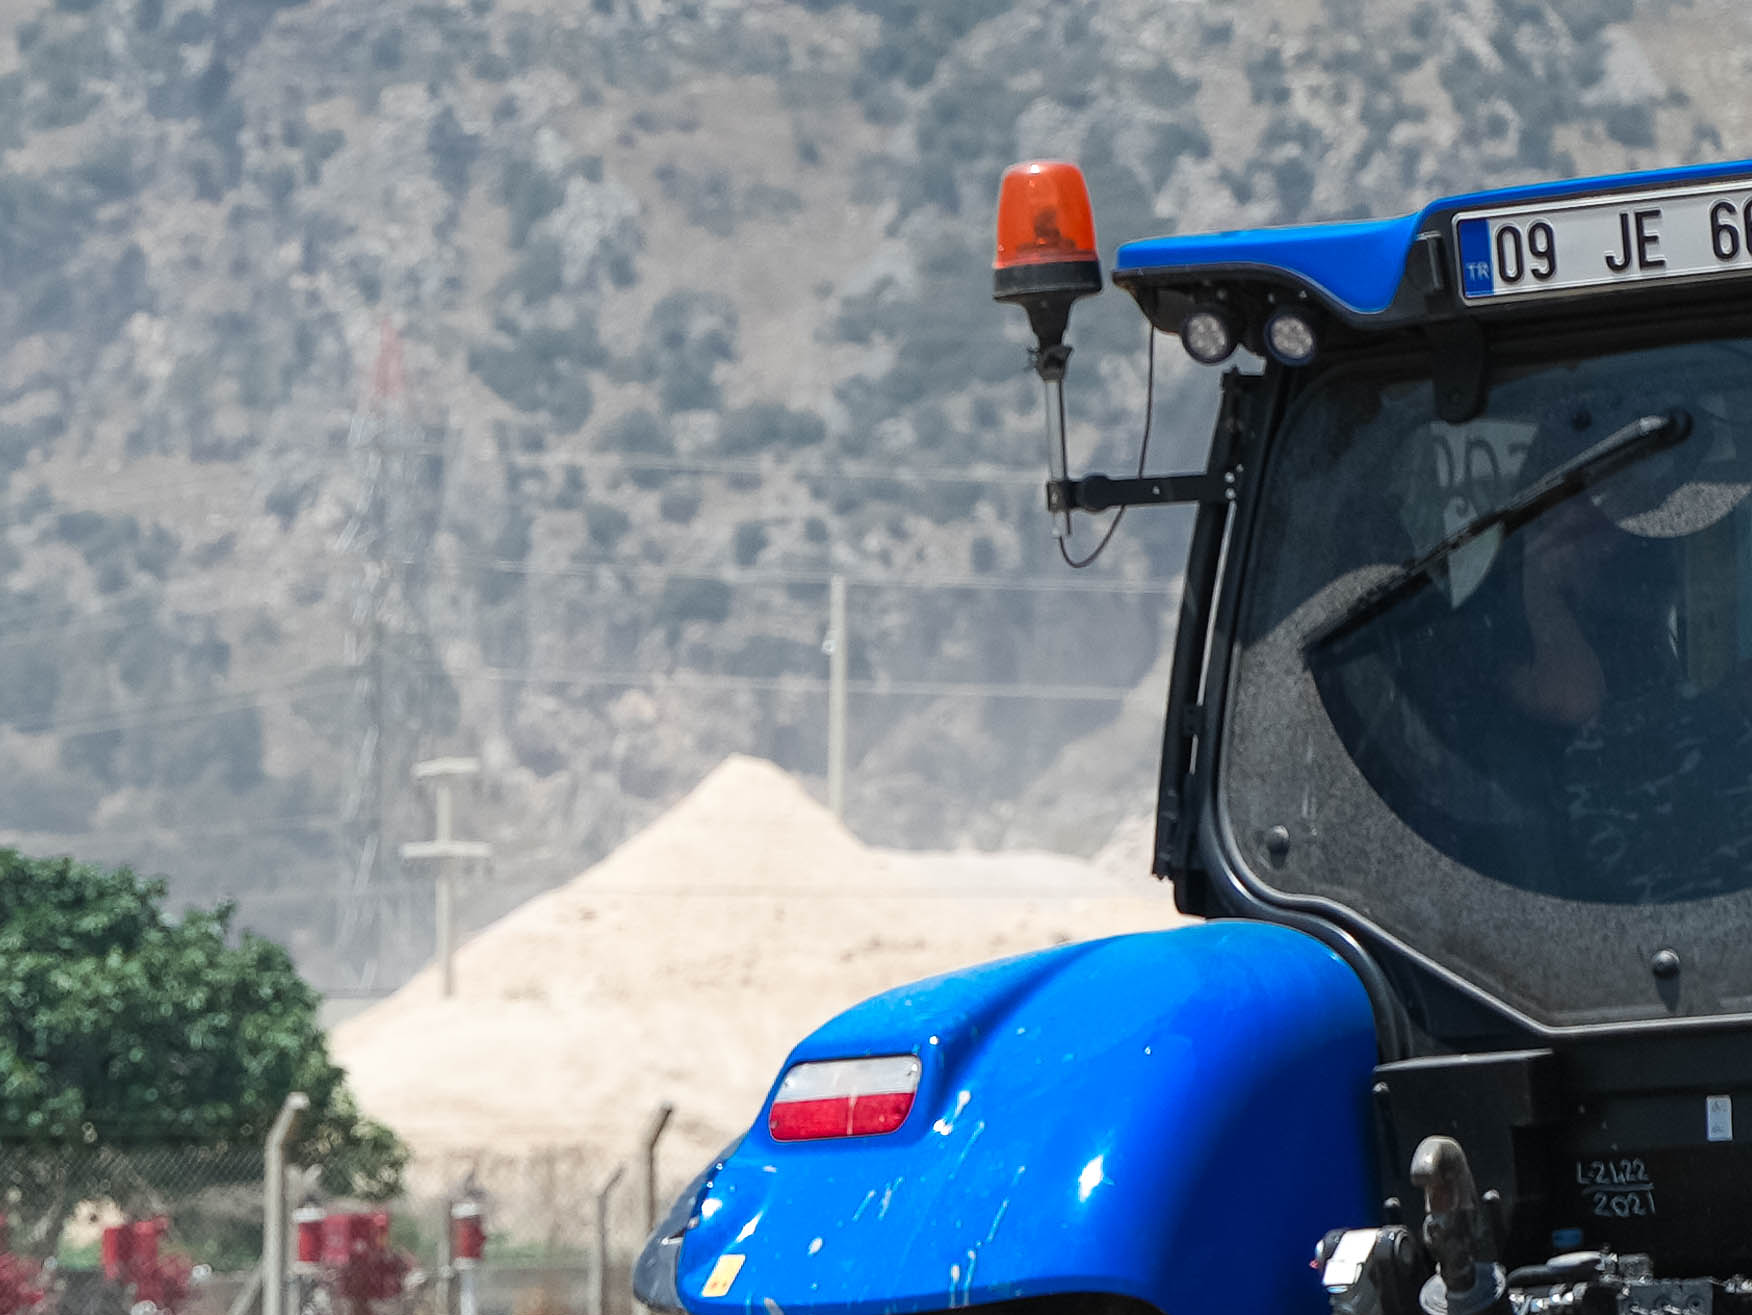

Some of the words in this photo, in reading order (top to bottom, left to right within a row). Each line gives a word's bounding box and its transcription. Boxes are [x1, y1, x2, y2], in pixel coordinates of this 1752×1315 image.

[1496, 219, 1559, 284] 09
[1604, 208, 1667, 273] JE
[1466, 260, 1490, 281] TR
[1593, 1191, 1656, 1218] 2021
